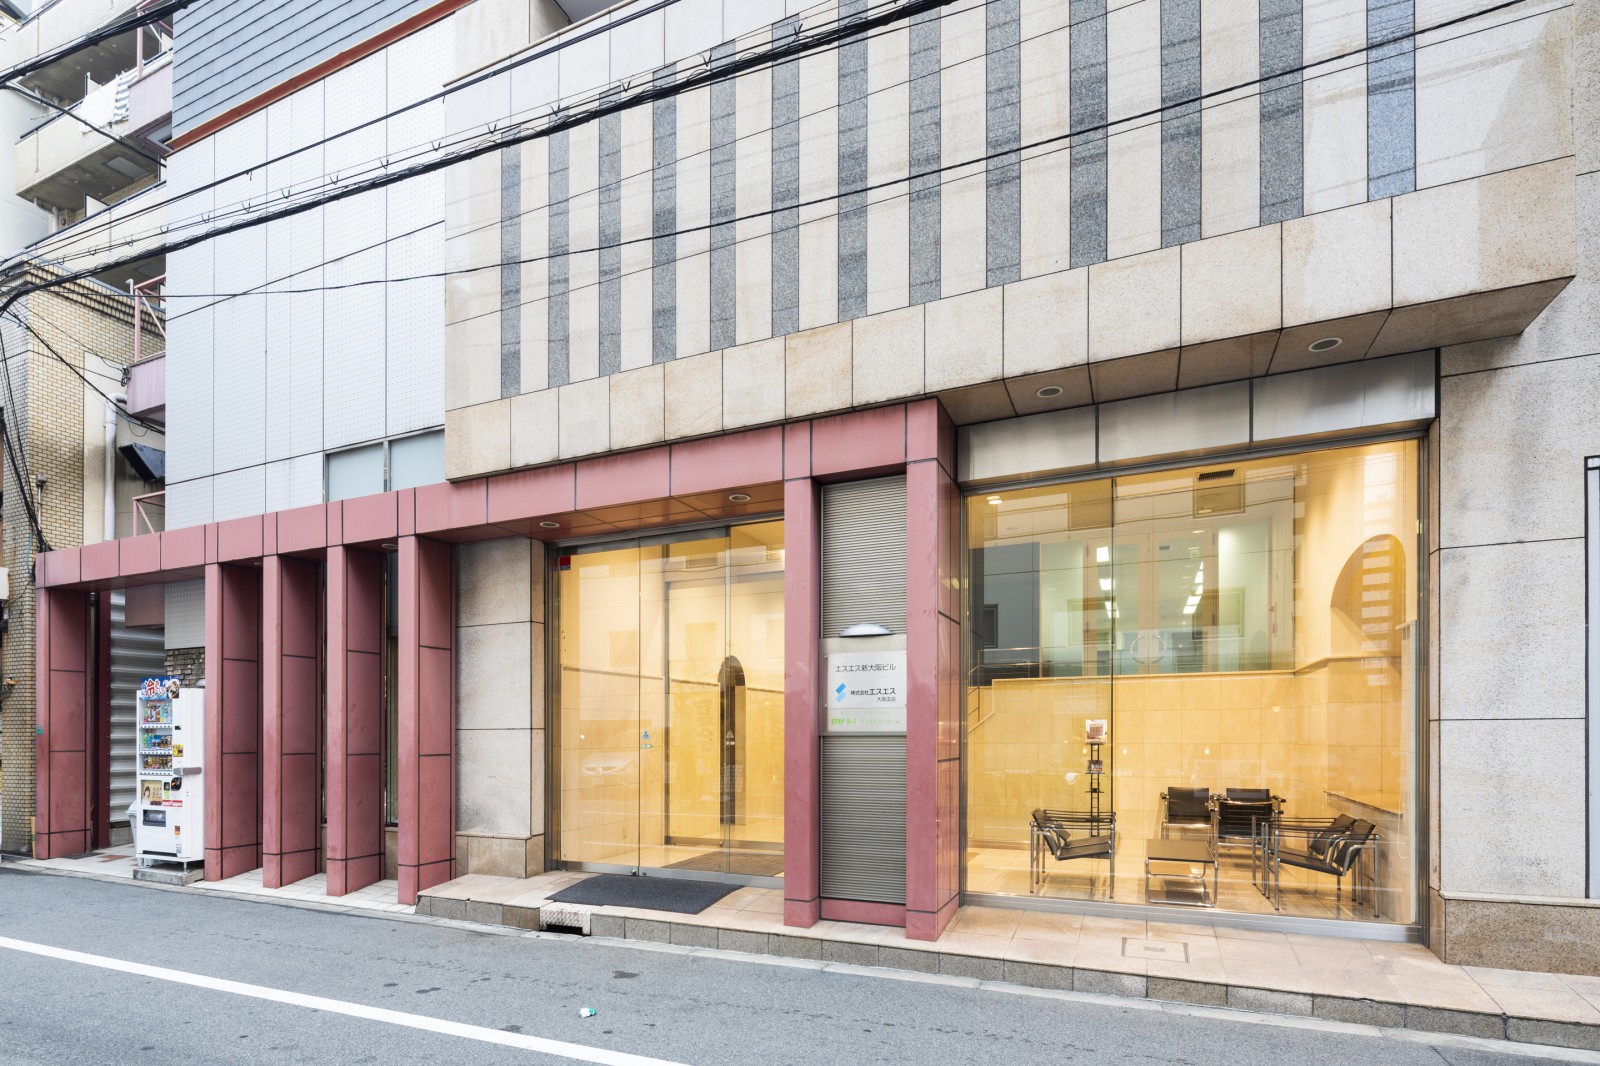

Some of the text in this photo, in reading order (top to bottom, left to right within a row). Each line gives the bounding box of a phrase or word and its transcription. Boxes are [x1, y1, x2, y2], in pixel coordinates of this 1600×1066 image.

[835, 664, 896, 672] エスエス新大阪ビル
[850, 688, 896, 696] 株式会社エスエス
